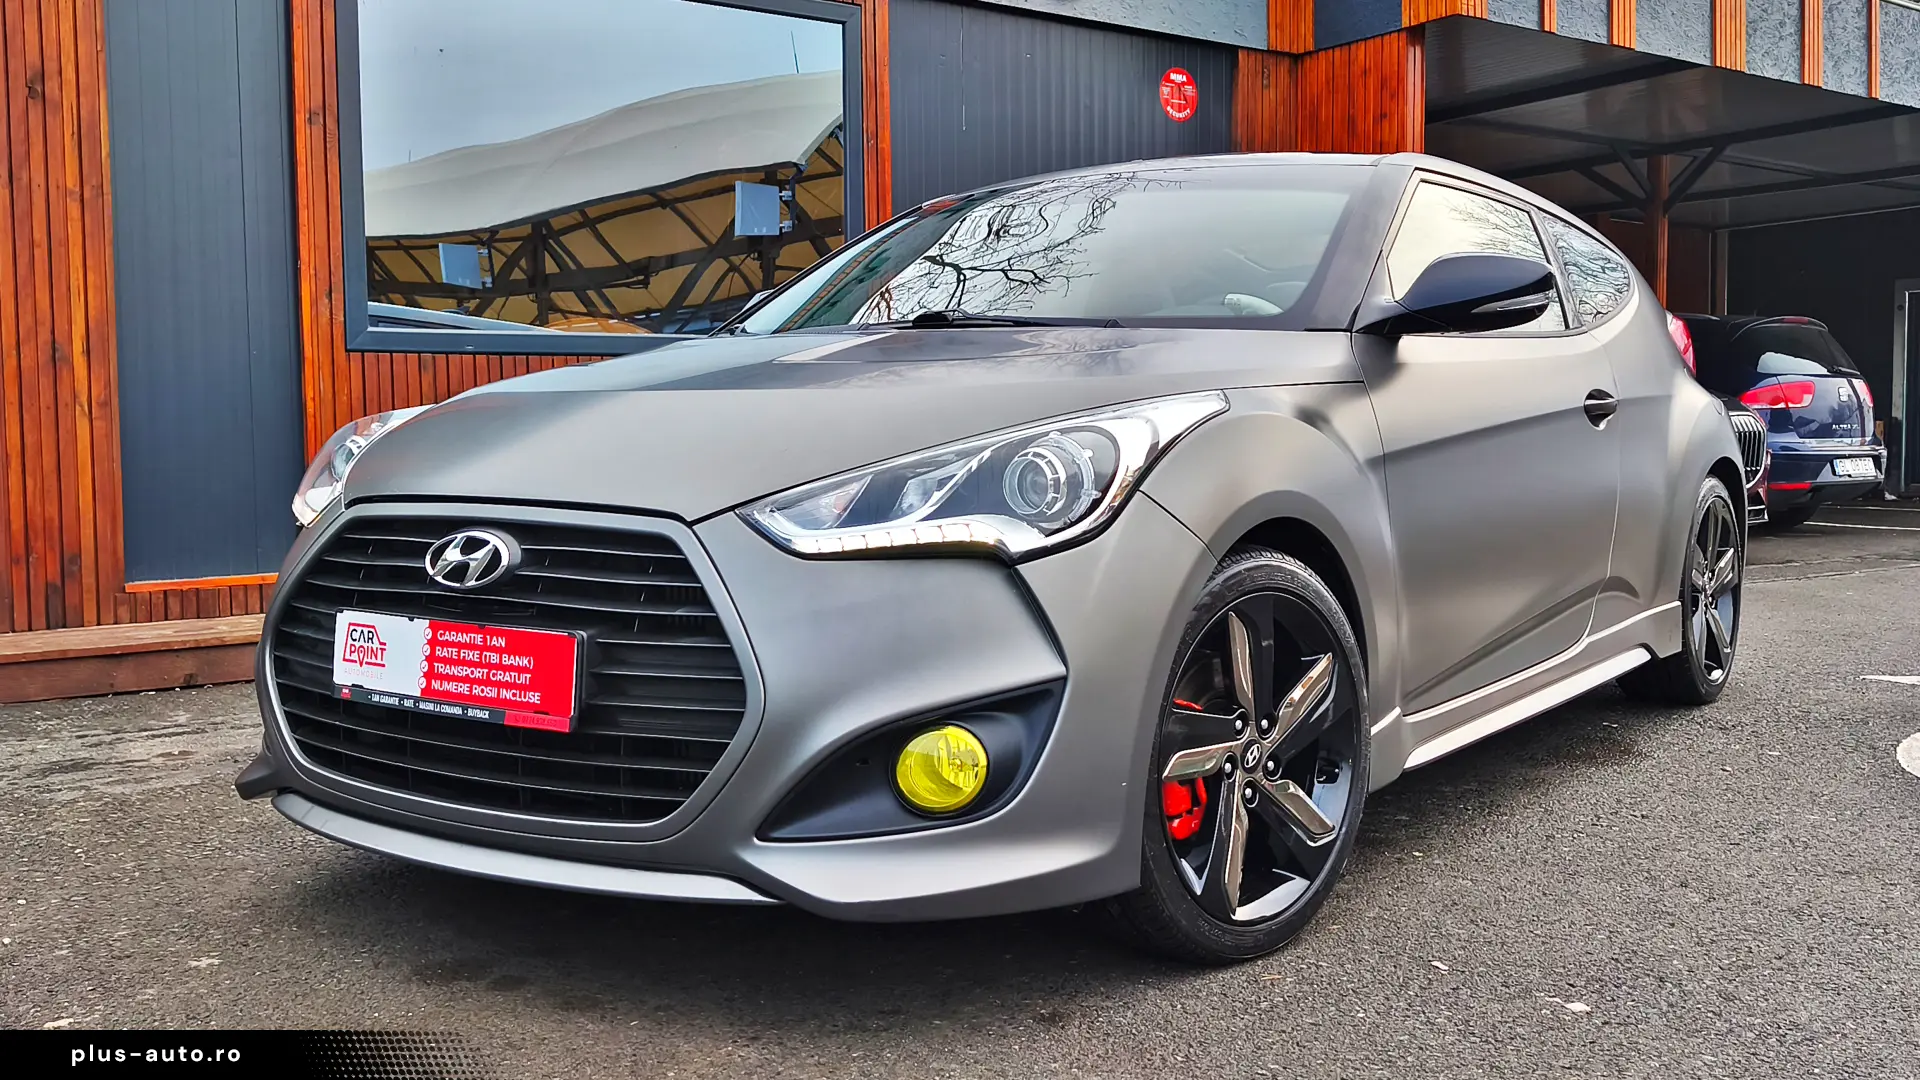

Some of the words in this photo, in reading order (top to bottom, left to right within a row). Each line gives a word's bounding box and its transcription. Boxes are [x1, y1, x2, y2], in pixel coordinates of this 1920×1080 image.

[350, 628, 375, 644] CAR
[437, 630, 484, 645] GARANTIE
[349, 643, 387, 665] POINT
[435, 646, 458, 659] RATE
[460, 649, 480, 662] FIXE
[482, 651, 499, 664] (TBI
[502, 654, 534, 669] BANK)
[433, 662, 488, 679] TRANSPORT
[490, 670, 532, 685] GRATUIT
[431, 679, 470, 694] NUMERE
[472, 685, 498, 699] ROSII
[500, 688, 541, 704] INCLUSE
[380, 695, 399, 705] GARANTIE
[467, 708, 490, 718] BUYBACK
